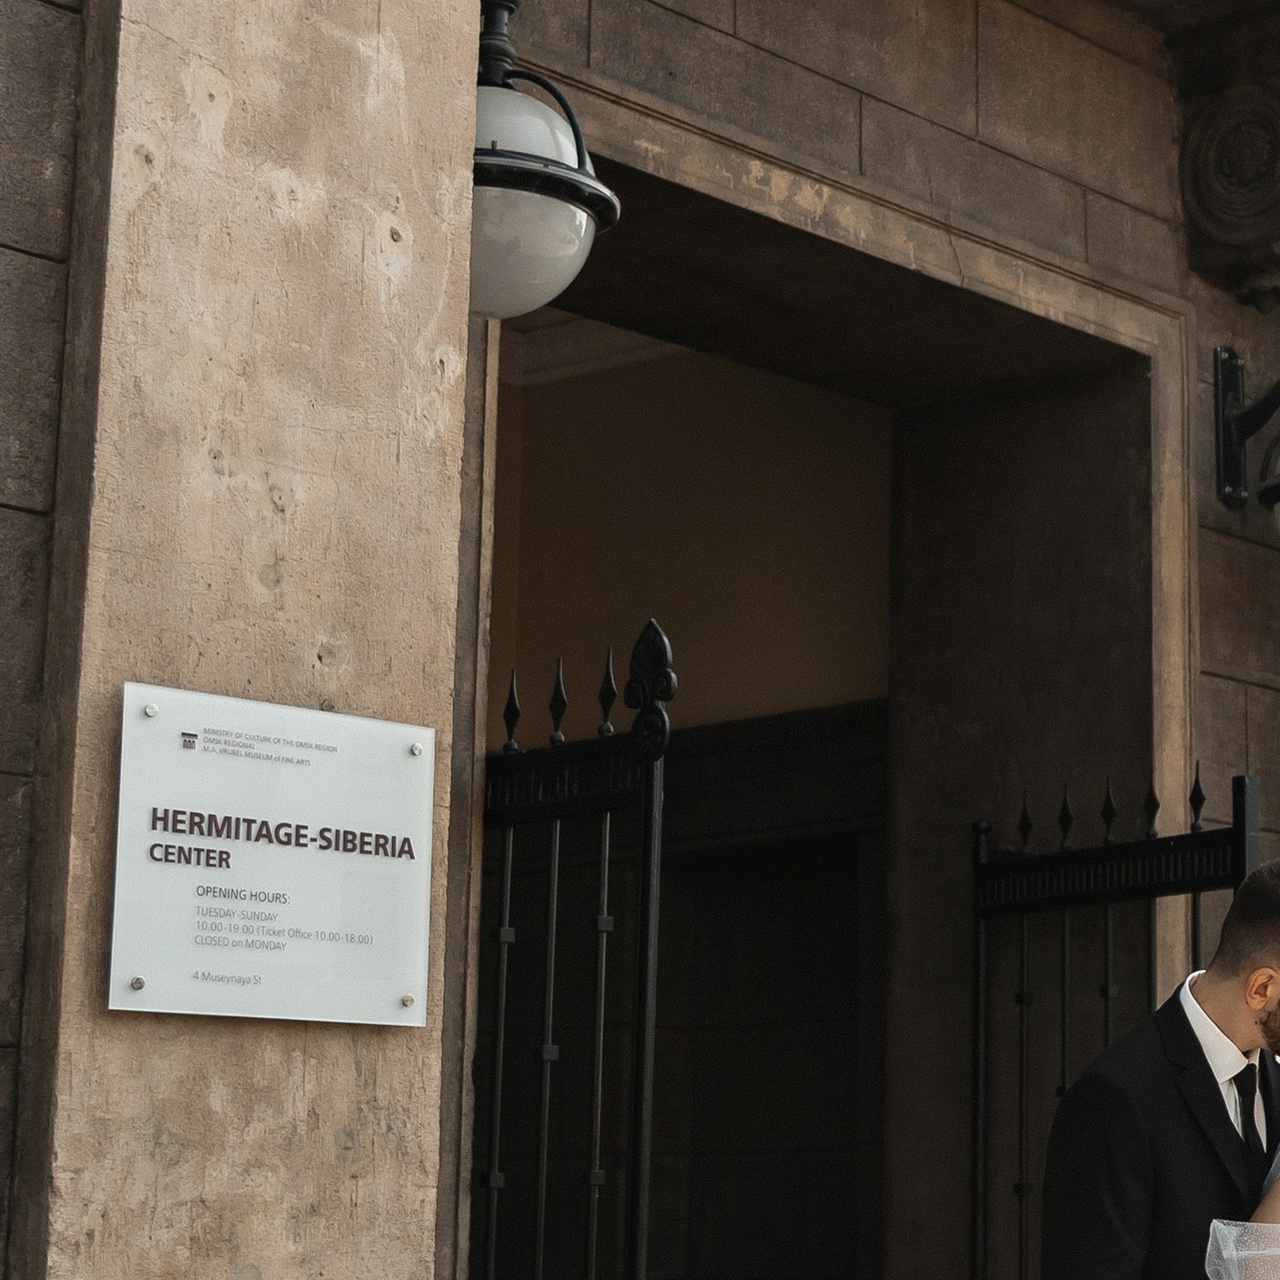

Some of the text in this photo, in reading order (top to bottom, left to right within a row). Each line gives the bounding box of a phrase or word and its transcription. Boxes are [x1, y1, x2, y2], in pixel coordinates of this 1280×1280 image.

[150, 806, 416, 860] HERMITAGE-SIBERIA
[149, 842, 232, 869] CENTER
[196, 885, 291, 905] OPENING HOURS:
[257, 925, 286, 938] (Ticket
[287, 928, 313, 940] Office
[194, 934, 288, 951] CLOSED on MONDAY
[193, 971, 200, 980] 4
[201, 971, 252, 986] Museynaya
